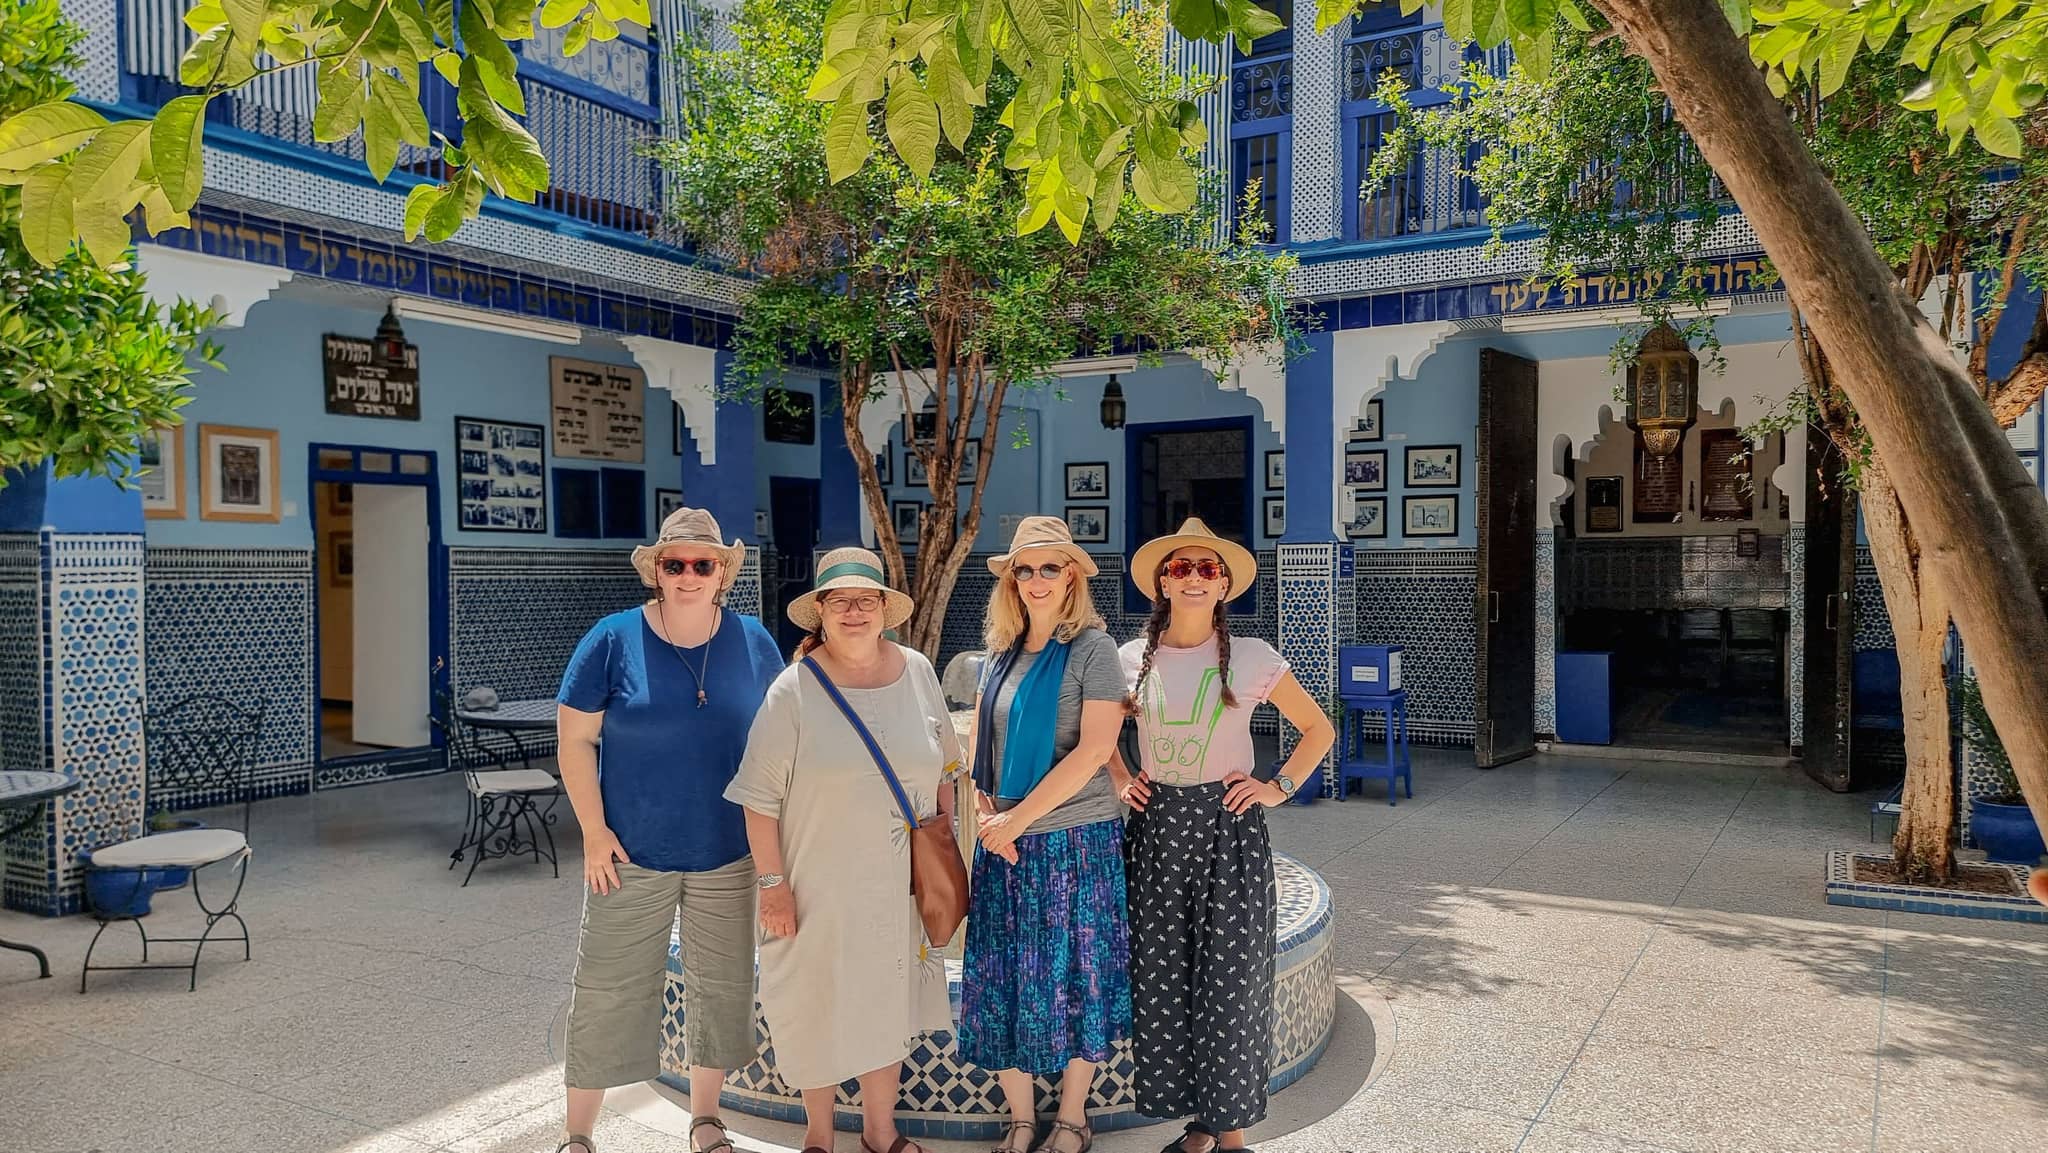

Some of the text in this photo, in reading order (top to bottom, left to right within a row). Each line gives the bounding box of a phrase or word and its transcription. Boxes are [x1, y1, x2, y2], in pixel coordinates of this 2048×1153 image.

[299, 231, 340, 273] על
[346, 246, 417, 286] עומד
[432, 264, 511, 305] העולם
[523, 283, 591, 321] דברים
[1490, 277, 1550, 311] לעד
[327, 339, 372, 364] התורה
[336, 375, 381, 402] שלום
